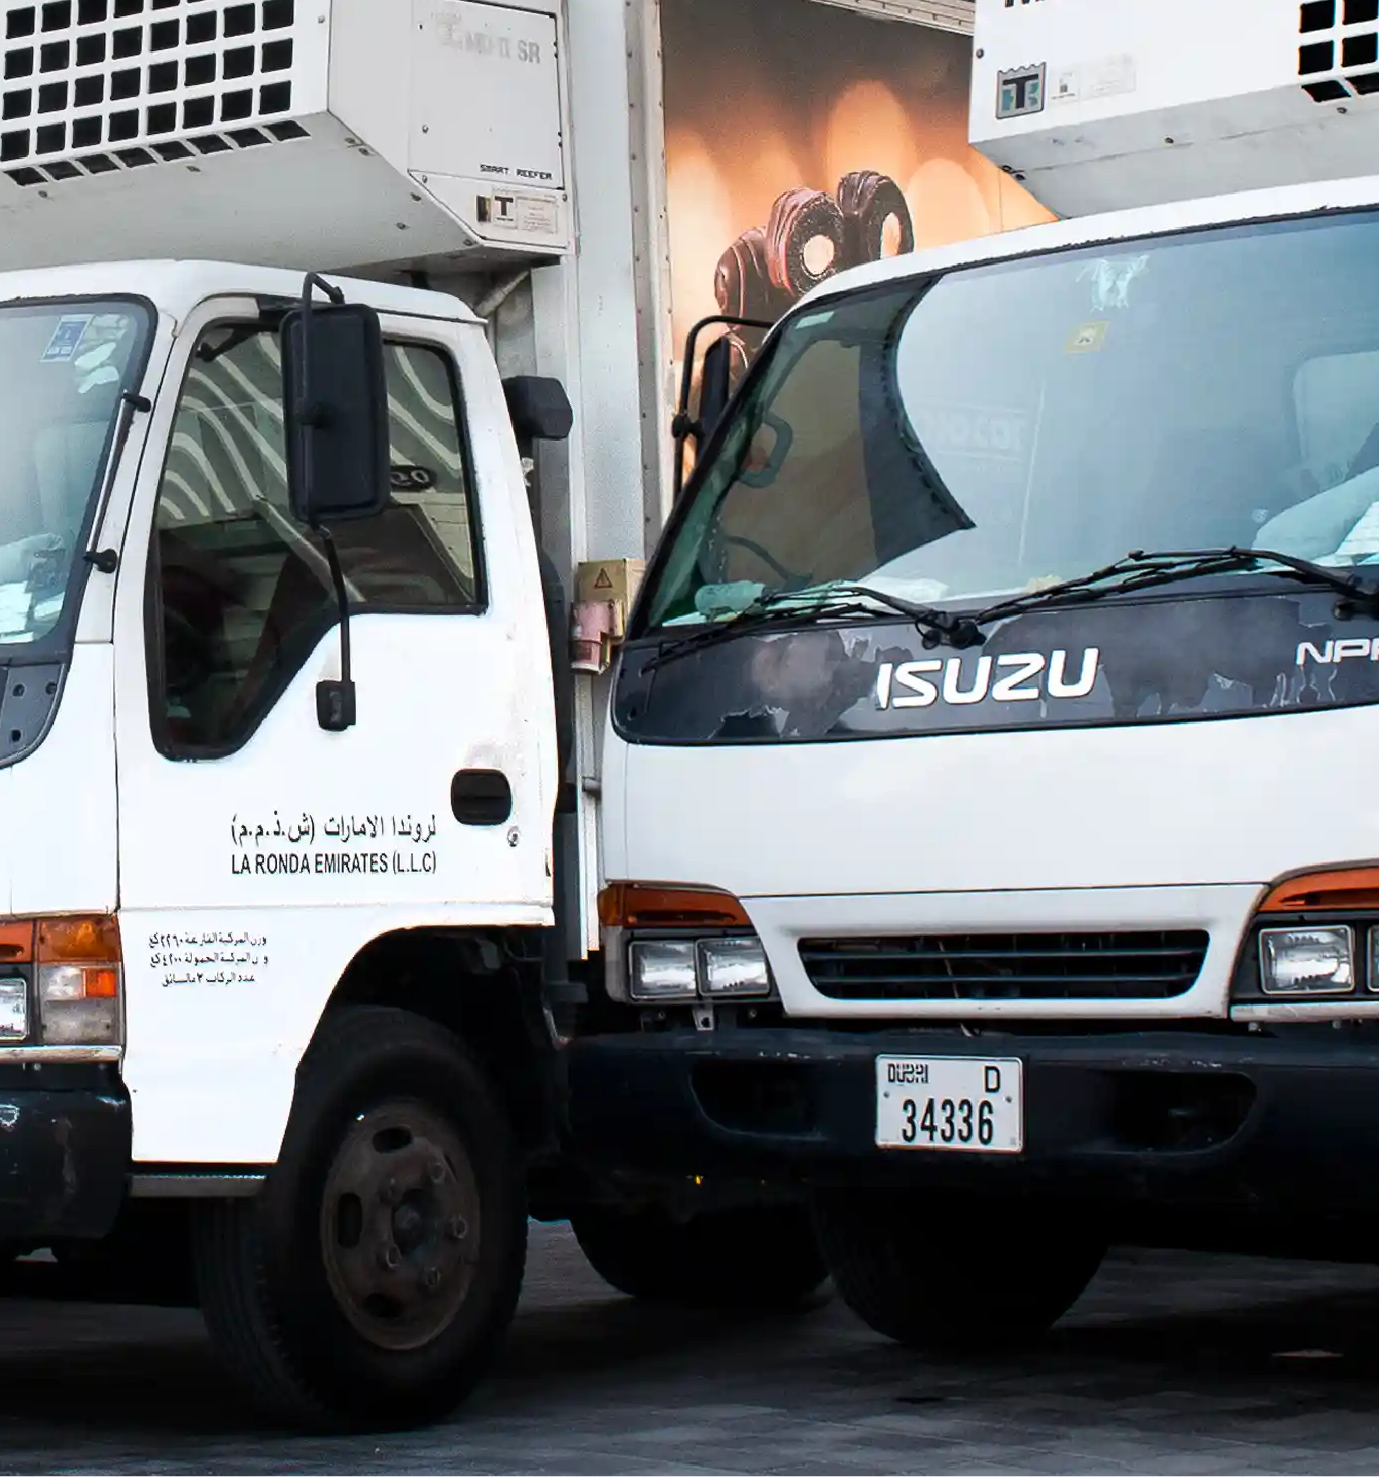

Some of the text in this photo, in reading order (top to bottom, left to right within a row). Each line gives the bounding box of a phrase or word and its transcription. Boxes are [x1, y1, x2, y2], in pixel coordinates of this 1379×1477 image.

[875, 647, 1100, 711] ISUZU
[231, 853, 252, 875] LA
[255, 853, 311, 875] RONDA
[314, 852, 389, 874] EMIRATES
[983, 1065, 1001, 1094] D
[901, 1097, 994, 1146] 34336
